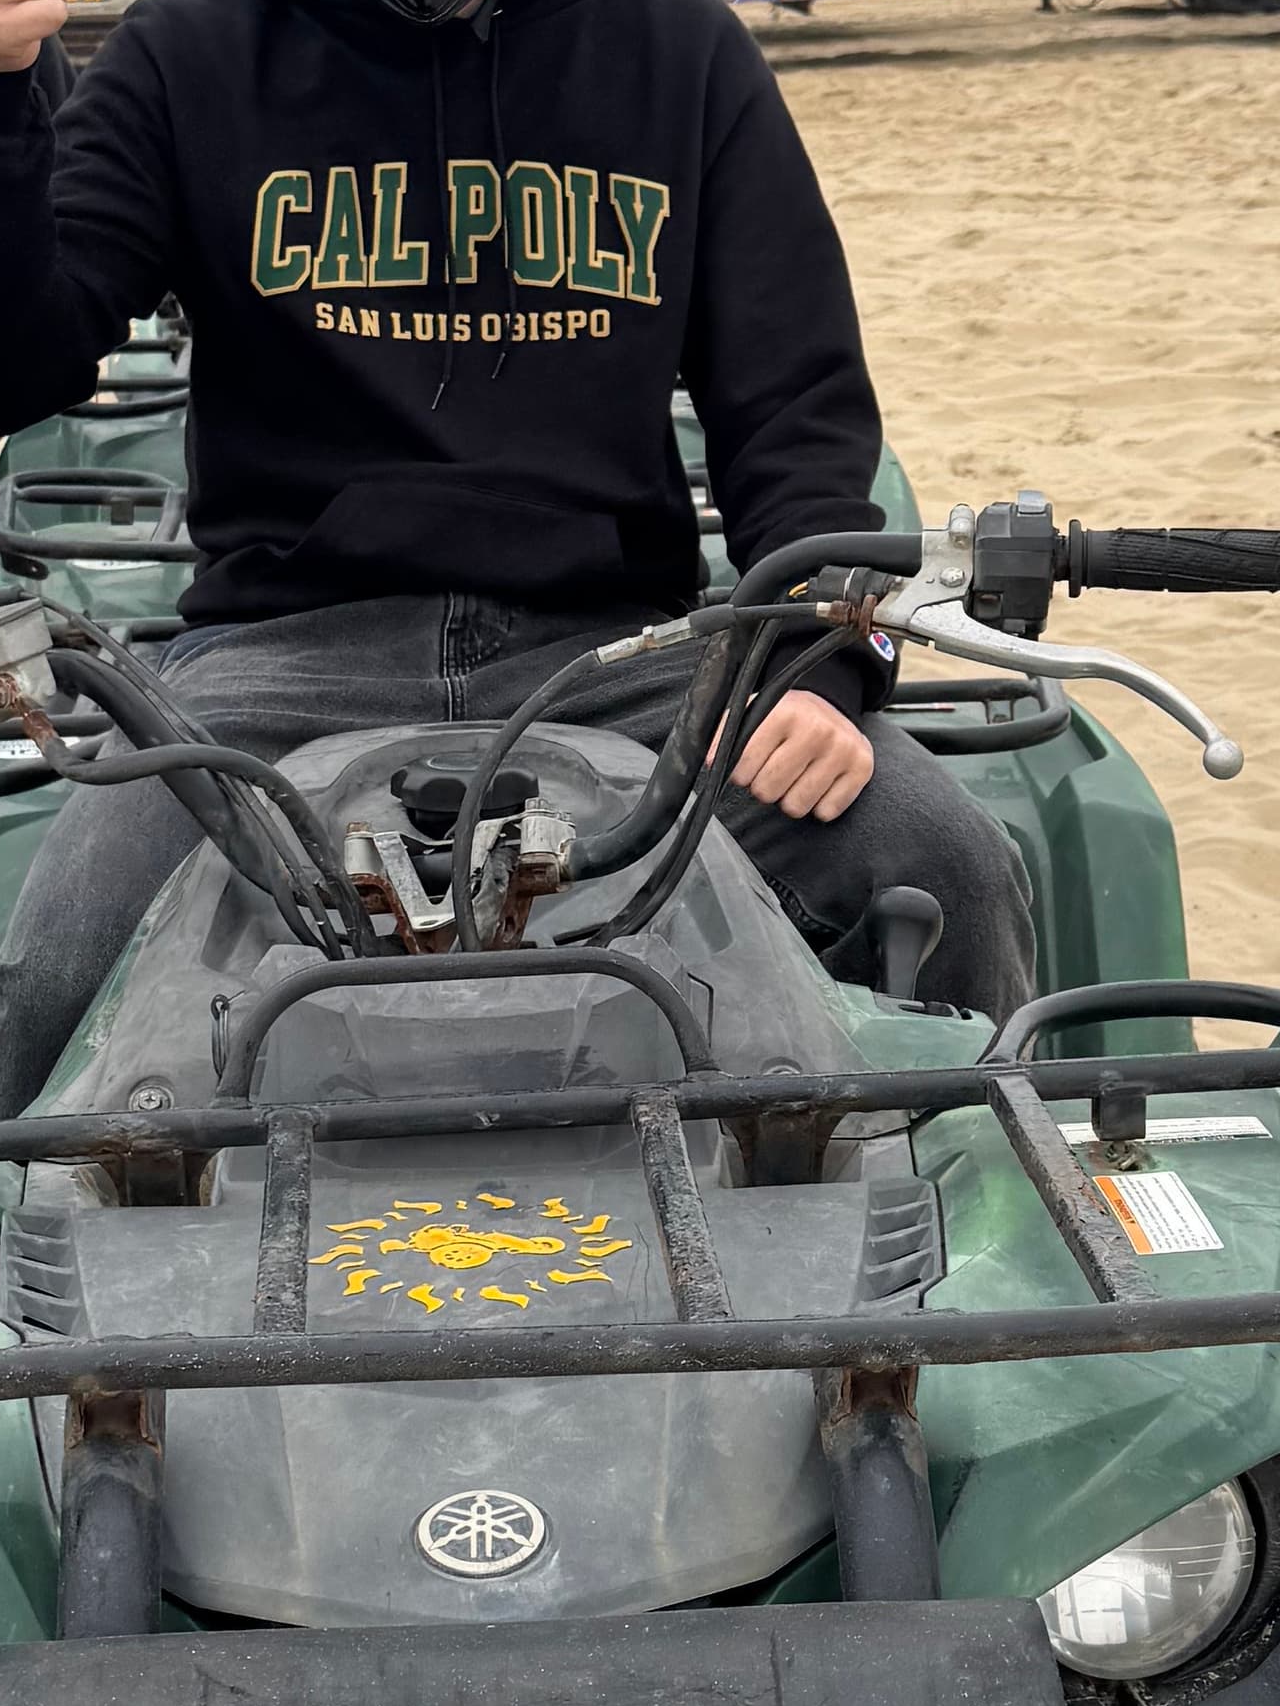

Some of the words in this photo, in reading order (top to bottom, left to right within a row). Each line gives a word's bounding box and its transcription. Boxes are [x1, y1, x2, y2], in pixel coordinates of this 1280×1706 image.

[250, 161, 430, 297] CAL
[444, 159, 671, 306] POLY
[315, 301, 381, 338] SAN
[390, 311, 472, 342] LUIS
[480, 308, 611, 342] OBISPO
